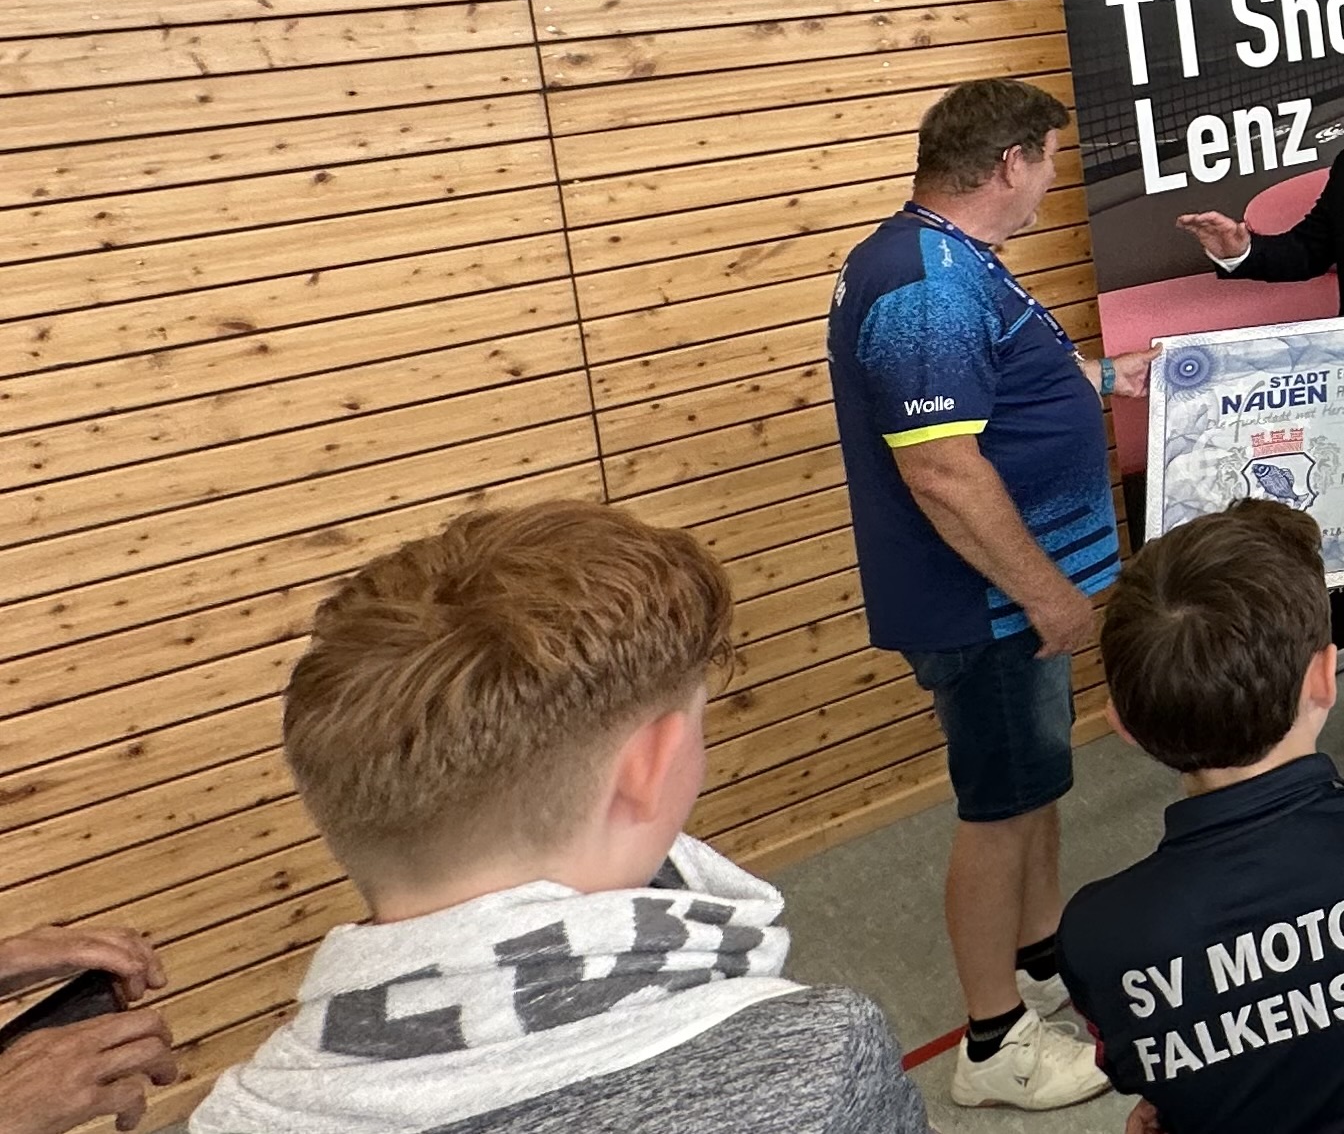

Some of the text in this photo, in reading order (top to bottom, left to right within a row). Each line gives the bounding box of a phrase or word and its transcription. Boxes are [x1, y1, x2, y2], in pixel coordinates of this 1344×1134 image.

[1134, 97, 1318, 195] Lenz
[1270, 370, 1331, 389] STADT
[904, 396, 955, 416] Wolle
[1221, 384, 1328, 415] NAUEN
[1121, 956, 1184, 1019] SV
